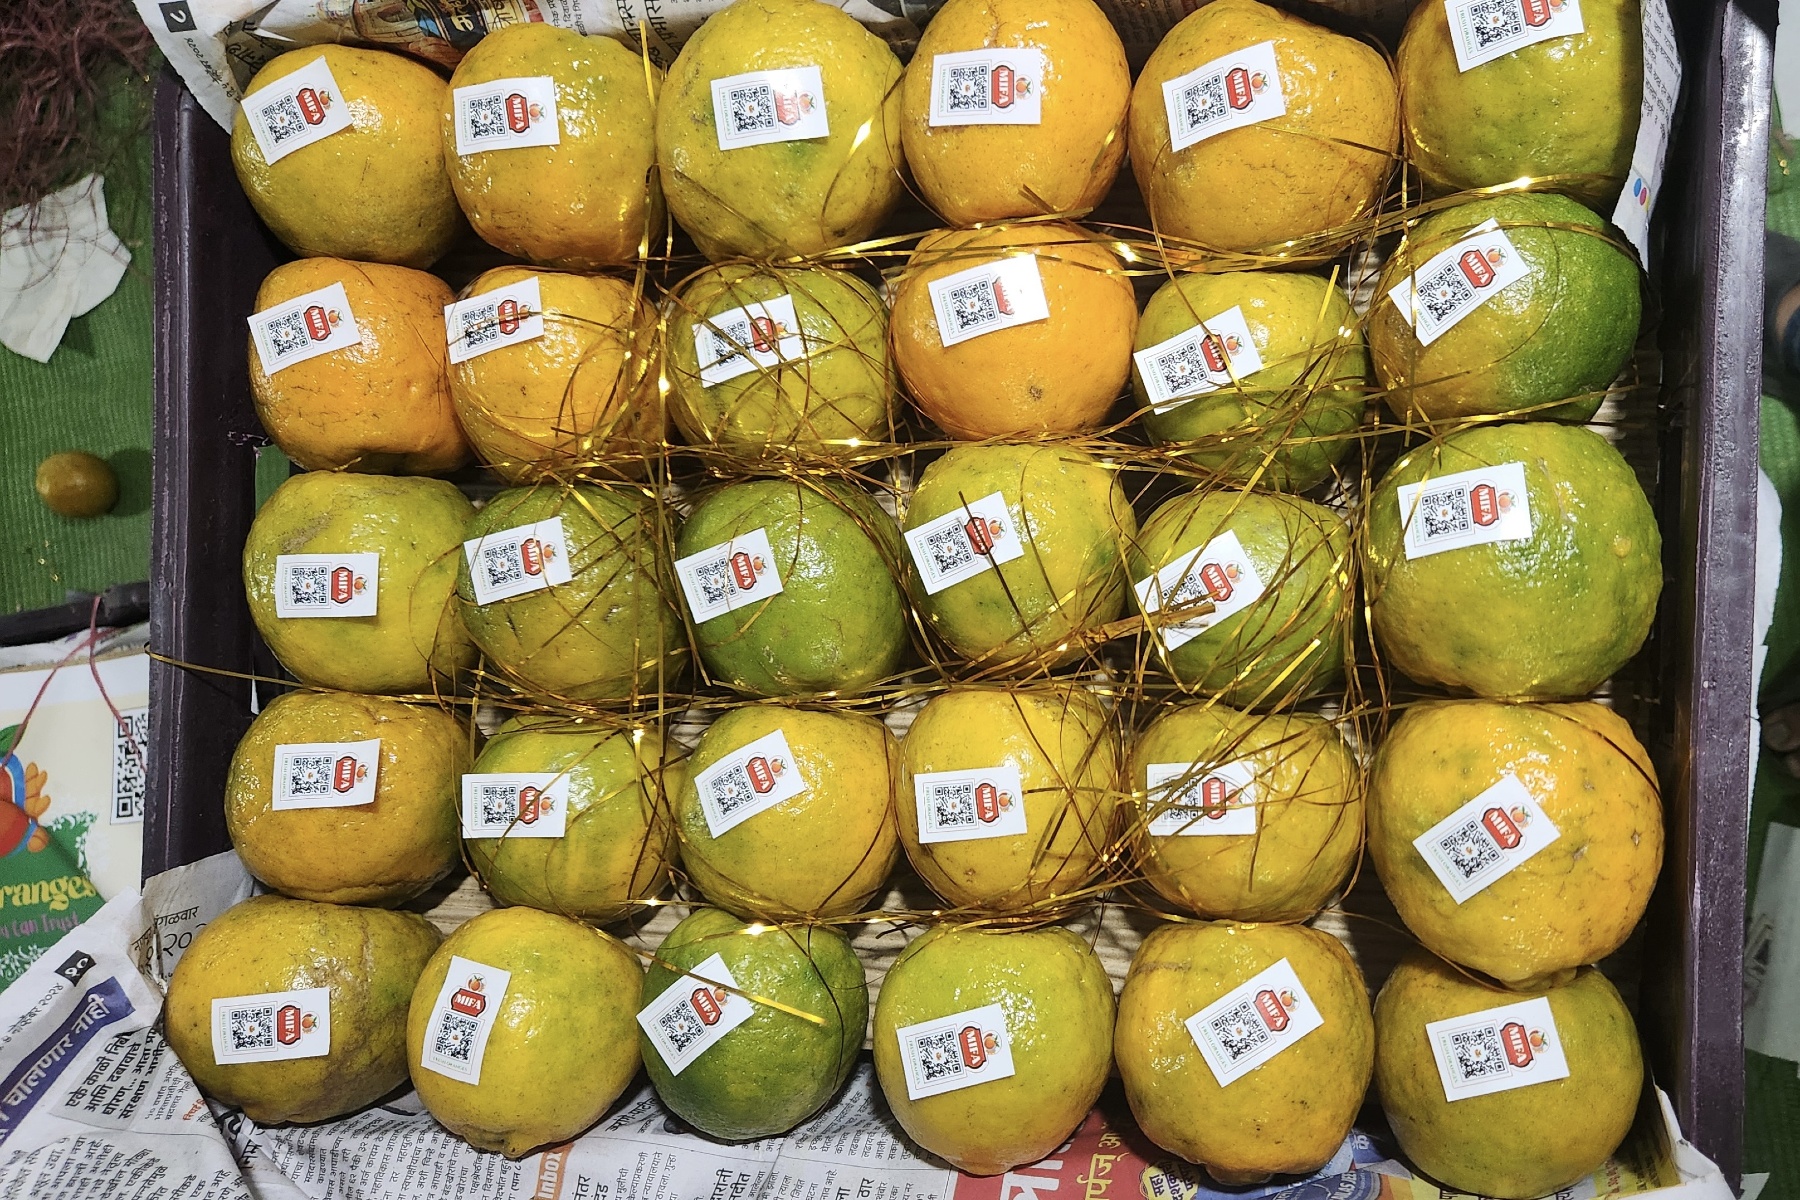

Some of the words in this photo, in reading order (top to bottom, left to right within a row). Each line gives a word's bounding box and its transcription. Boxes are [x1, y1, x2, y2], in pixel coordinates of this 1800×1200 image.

[1528, 0, 1544, 23] IFA
[998, 70, 1010, 104] MIFA
[1232, 70, 1247, 106] MIFA
[301, 89, 321, 122] MIFA
[512, 97, 524, 128] MIFA
[781, 92, 795, 120] IFA
[1463, 252, 1491, 285] MIFA
[309, 308, 326, 338] MIFA
[1477, 486, 1492, 523] MIFA
[525, 540, 540, 572] MIFA
[734, 555, 752, 587] MIFA
[337, 570, 347, 600] MIFA
[1205, 564, 1229, 598] MIFA
[339, 760, 351, 788] MIFA
[751, 758, 769, 791] MIFA
[980, 786, 994, 818] MIFA
[1486, 810, 1518, 845] MIFA
[0, 875, 97, 911] ranges
[64, 953, 91, 981] १०
[38, 980, 65, 1008] २०२४
[454, 992, 482, 1010] MIFA
[694, 990, 718, 1021] MIFA
[1259, 992, 1285, 1028] MIFA
[71, 994, 110, 1035] नाही
[284, 1009, 295, 1040] MIFA
[964, 1029, 981, 1065] MIFA
[1507, 1025, 1528, 1063] MIFA
[82, 1055, 113, 1088] काळी
[83, 1079, 113, 1116] आणि
[108, 1038, 142, 1086] दबावाचे
[131, 1046, 154, 1076] आता
[116, 1076, 151, 1124] संरक्षण
[51, 1155, 76, 1192] आपला
[70, 1134, 88, 1156] नवा
[100, 1148, 125, 1180] नेतृत्व
[313, 1148, 331, 1185] काढण्यात
[326, 1135, 344, 1177] आघाडीच्या
[349, 1153, 363, 1172] पैकी
[358, 1169, 371, 1187] अर्ज
[365, 1143, 380, 1170] कायम
[421, 1146, 436, 1167] चिन्हे
[66, 1160, 88, 1190] झाली
[336, 1171, 348, 1194] असले
[370, 1152, 391, 1196] महाविकास
[416, 1169, 430, 1190] अशी
[430, 1161, 444, 1191] आघाडी
[442, 1158, 458, 1196] बंडखोरांचे
[537, 1149, 562, 1199] Inbox
[643, 1149, 663, 1197] न्यायालयाने
[747, 1169, 766, 1200] आलेल्या
[777, 1174, 793, 1196] त्याला
[791, 1178, 805, 1199] जिवंत
